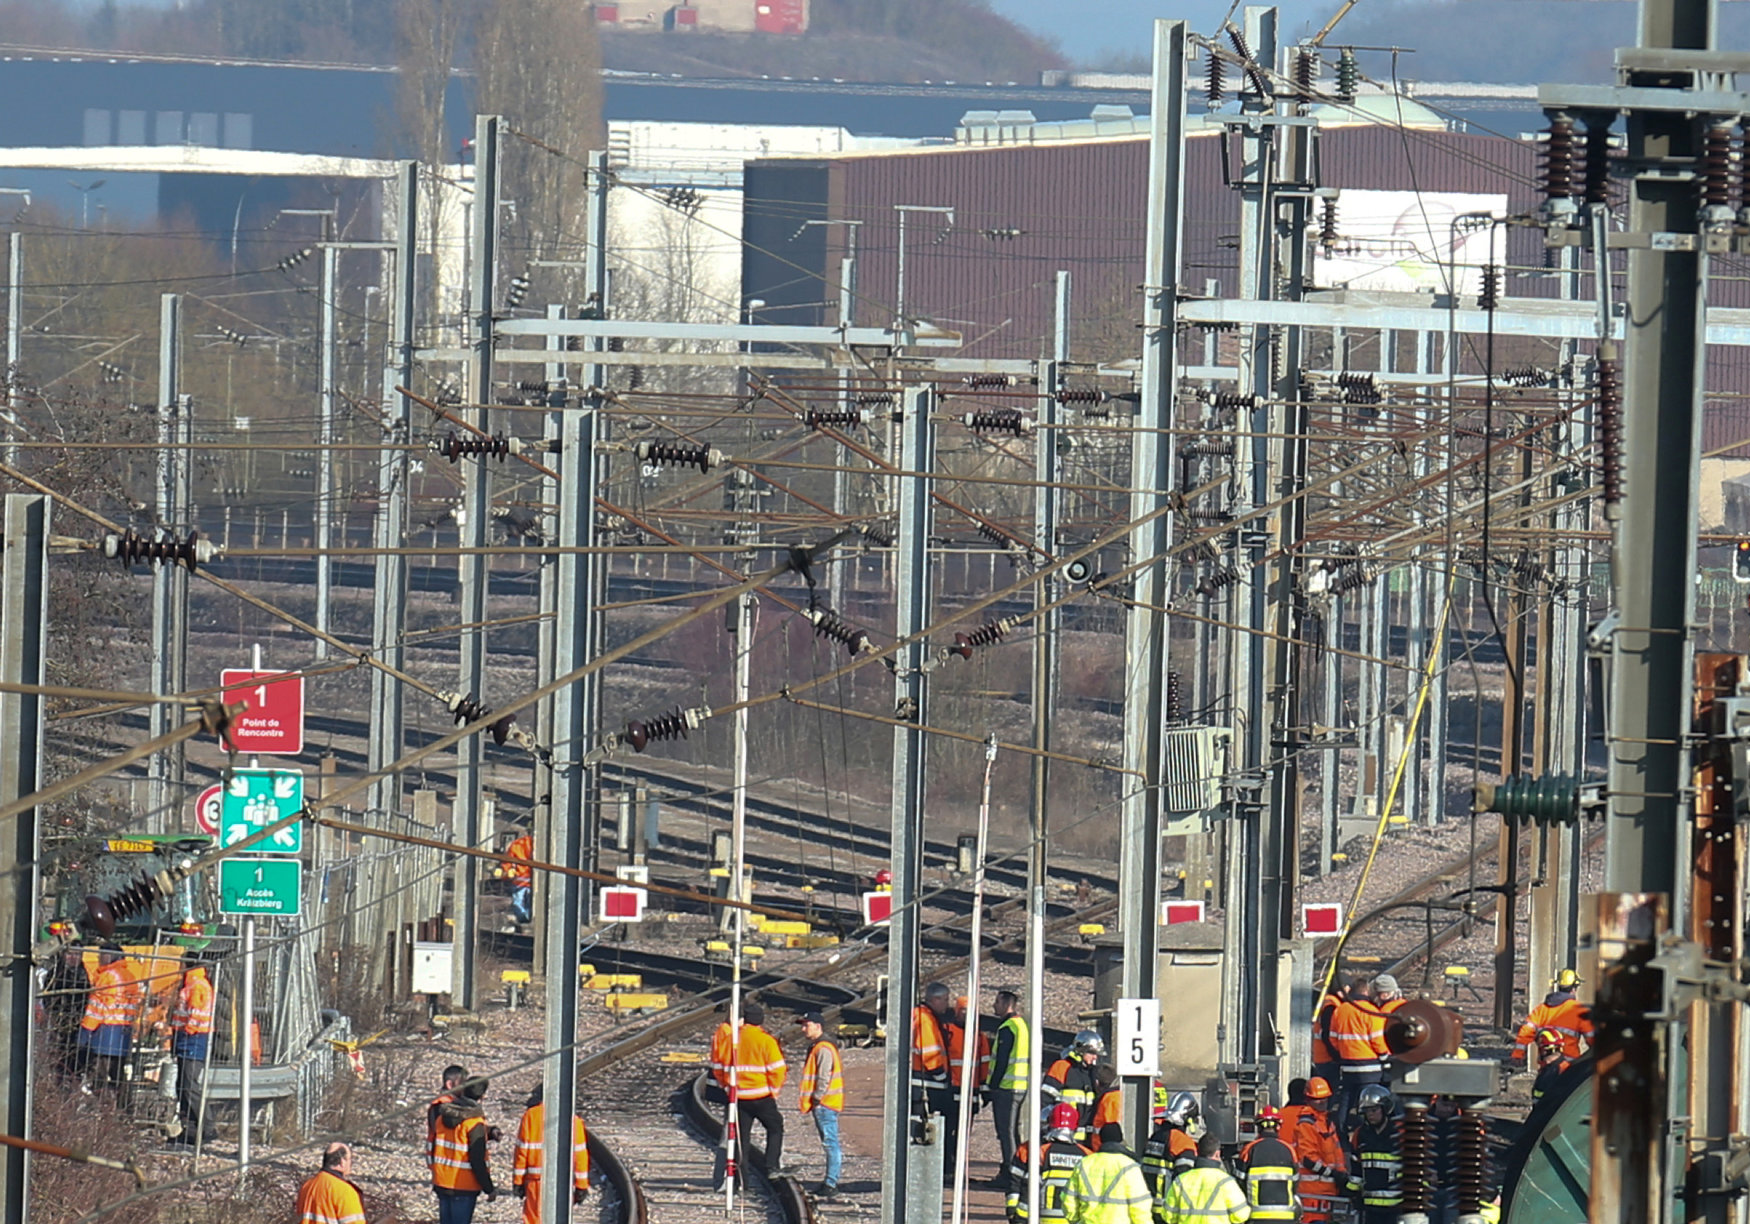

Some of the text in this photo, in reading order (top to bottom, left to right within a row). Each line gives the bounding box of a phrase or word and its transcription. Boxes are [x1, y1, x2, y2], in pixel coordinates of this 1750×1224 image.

[254, 685, 266, 708] 1
[242, 718, 280, 728] Point de
[237, 728, 284, 737] Rencontre
[254, 867, 264, 883] 1
